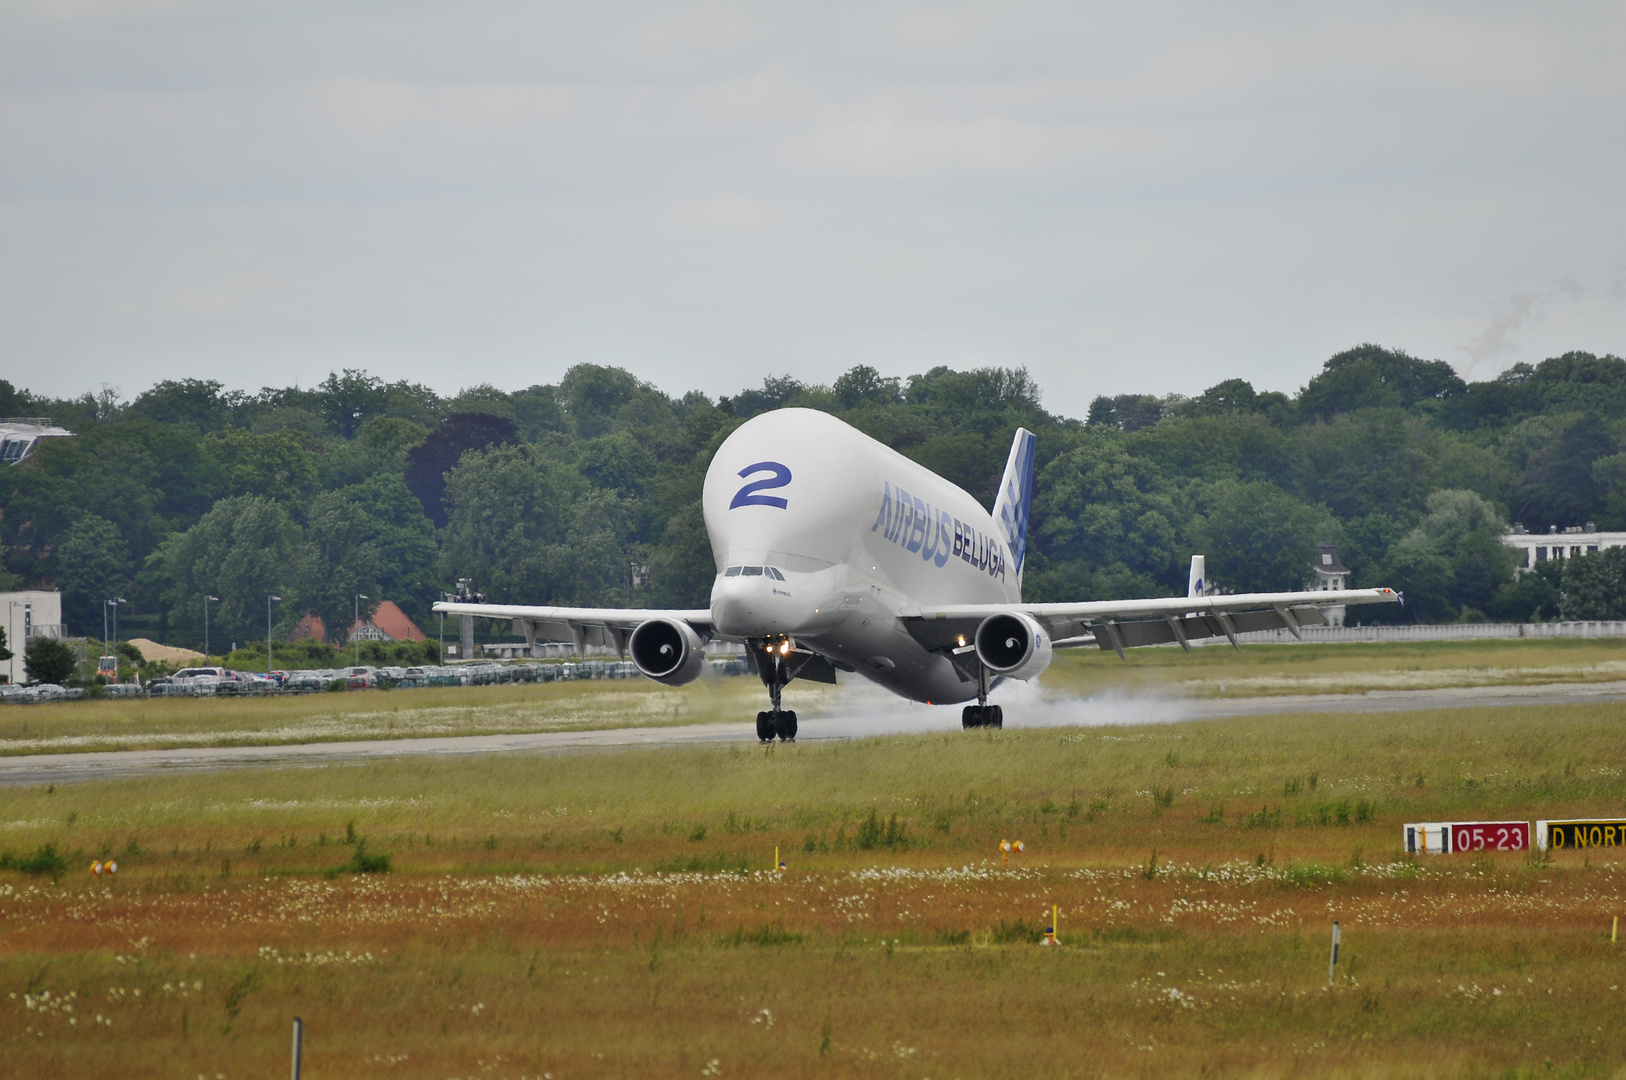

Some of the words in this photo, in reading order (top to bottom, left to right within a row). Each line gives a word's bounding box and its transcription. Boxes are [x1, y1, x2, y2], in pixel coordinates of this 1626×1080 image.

[729, 461, 792, 510] 2
[871, 480, 951, 568] AIRBUS
[952, 518, 1005, 583] BELUGA
[1457, 827, 1523, 851] 05-23
[1553, 827, 1565, 849] D
